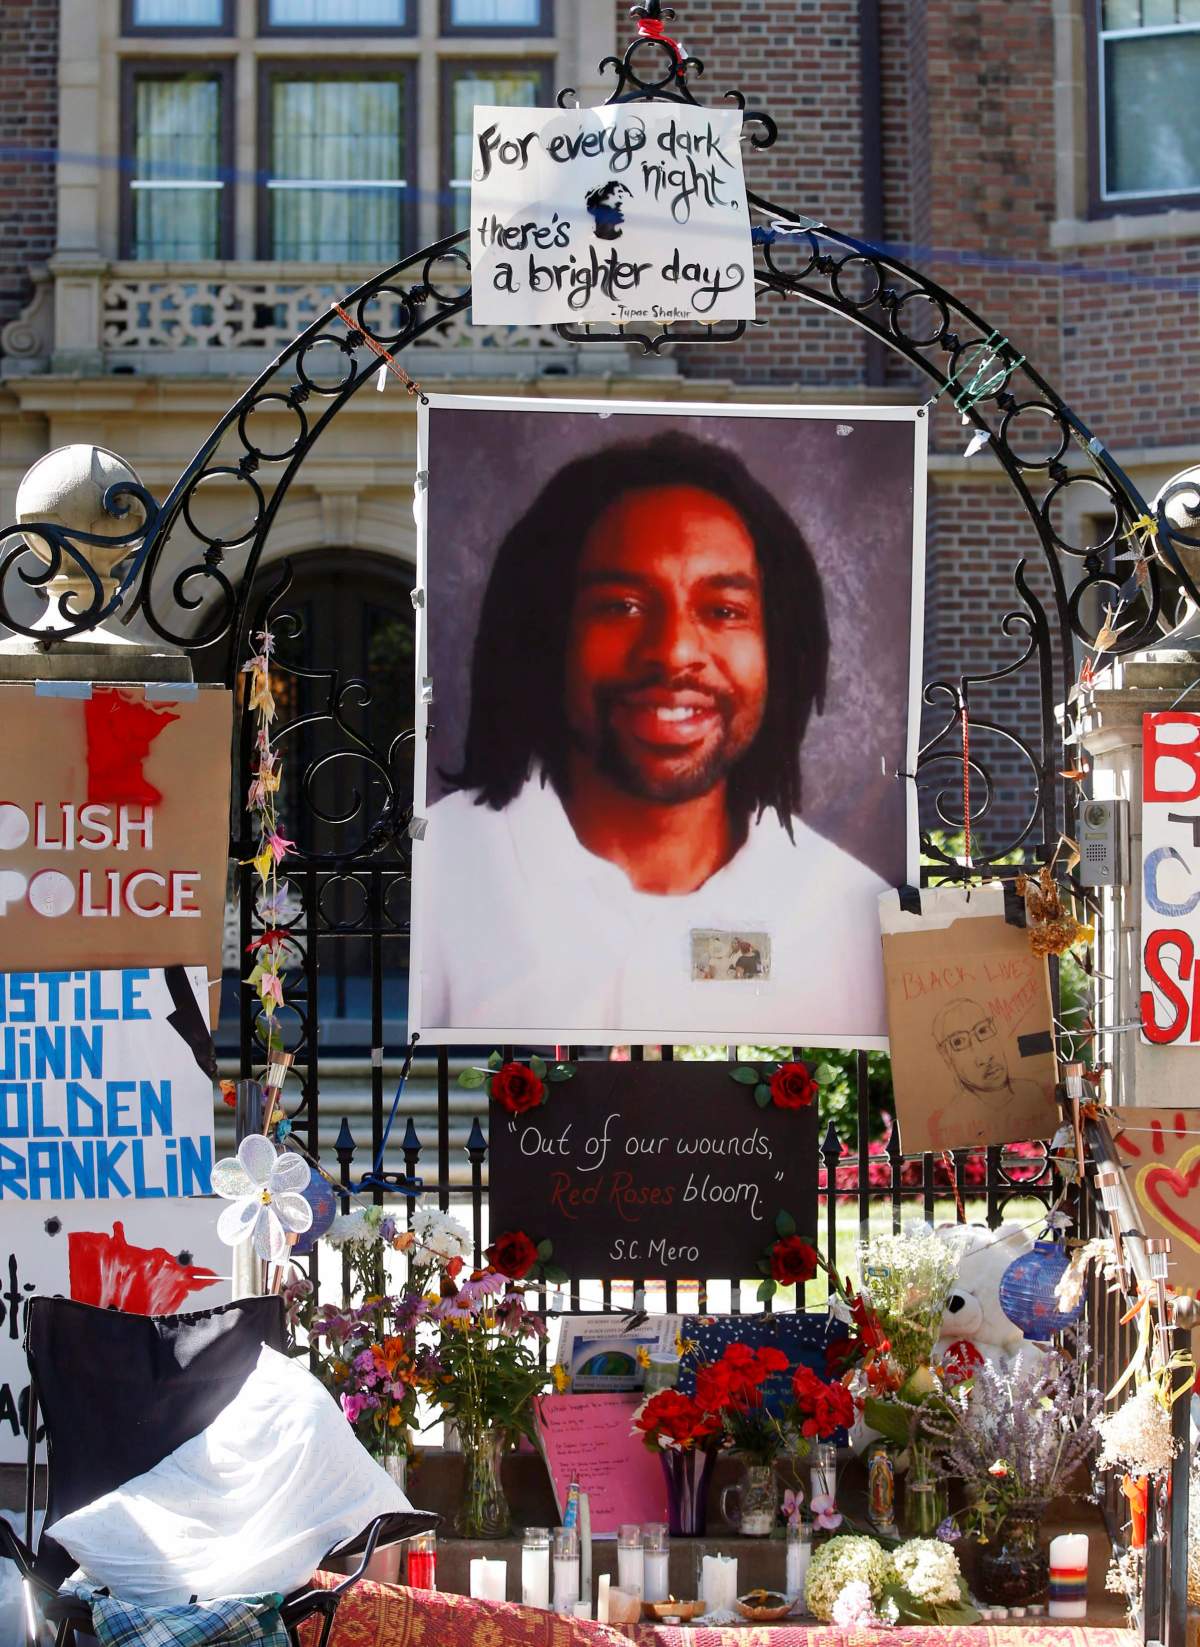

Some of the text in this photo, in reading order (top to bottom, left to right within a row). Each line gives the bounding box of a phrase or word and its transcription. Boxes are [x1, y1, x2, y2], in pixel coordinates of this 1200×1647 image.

[474, 115, 736, 182] For every dark
[476, 212, 571, 251] there's
[493, 244, 745, 314] a brighter day
[651, 304, 692, 319] Shakur
[0, 868, 202, 918] POLICE
[902, 957, 1035, 1001] BLACK LIVES
[577, 1113, 621, 1172] of
[625, 1136, 669, 1154] our
[677, 1128, 773, 1160] wounds,
[550, 1171, 600, 1219] Red
[609, 1171, 675, 1222] Roses
[648, 1238, 699, 1266] Mero
